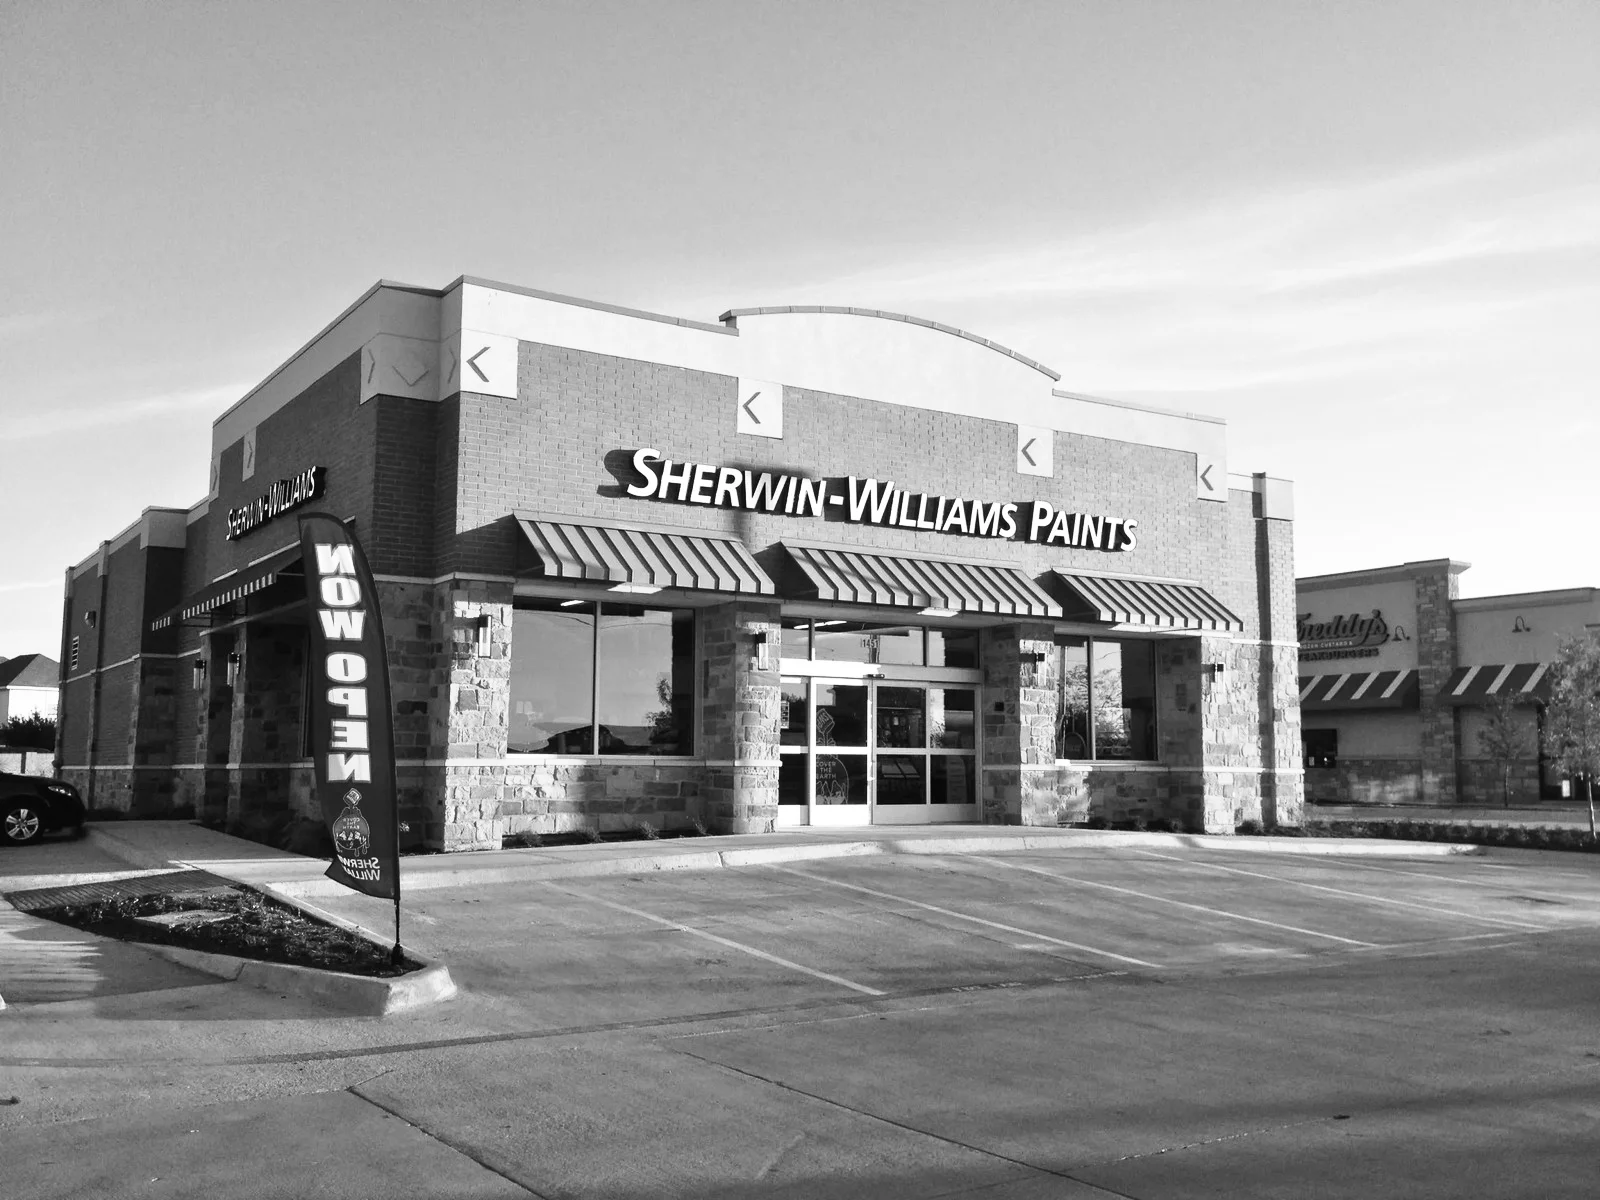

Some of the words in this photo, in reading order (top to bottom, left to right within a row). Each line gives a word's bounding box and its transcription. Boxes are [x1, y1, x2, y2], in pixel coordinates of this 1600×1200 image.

[226, 465, 316, 541] SHERWIN-WILLIAMS
[626, 447, 1018, 539] SHERWIN-WILLIAMS
[1030, 500, 1139, 552] PAINTS
[1298, 648, 1379, 661] TEAKBURGERS
